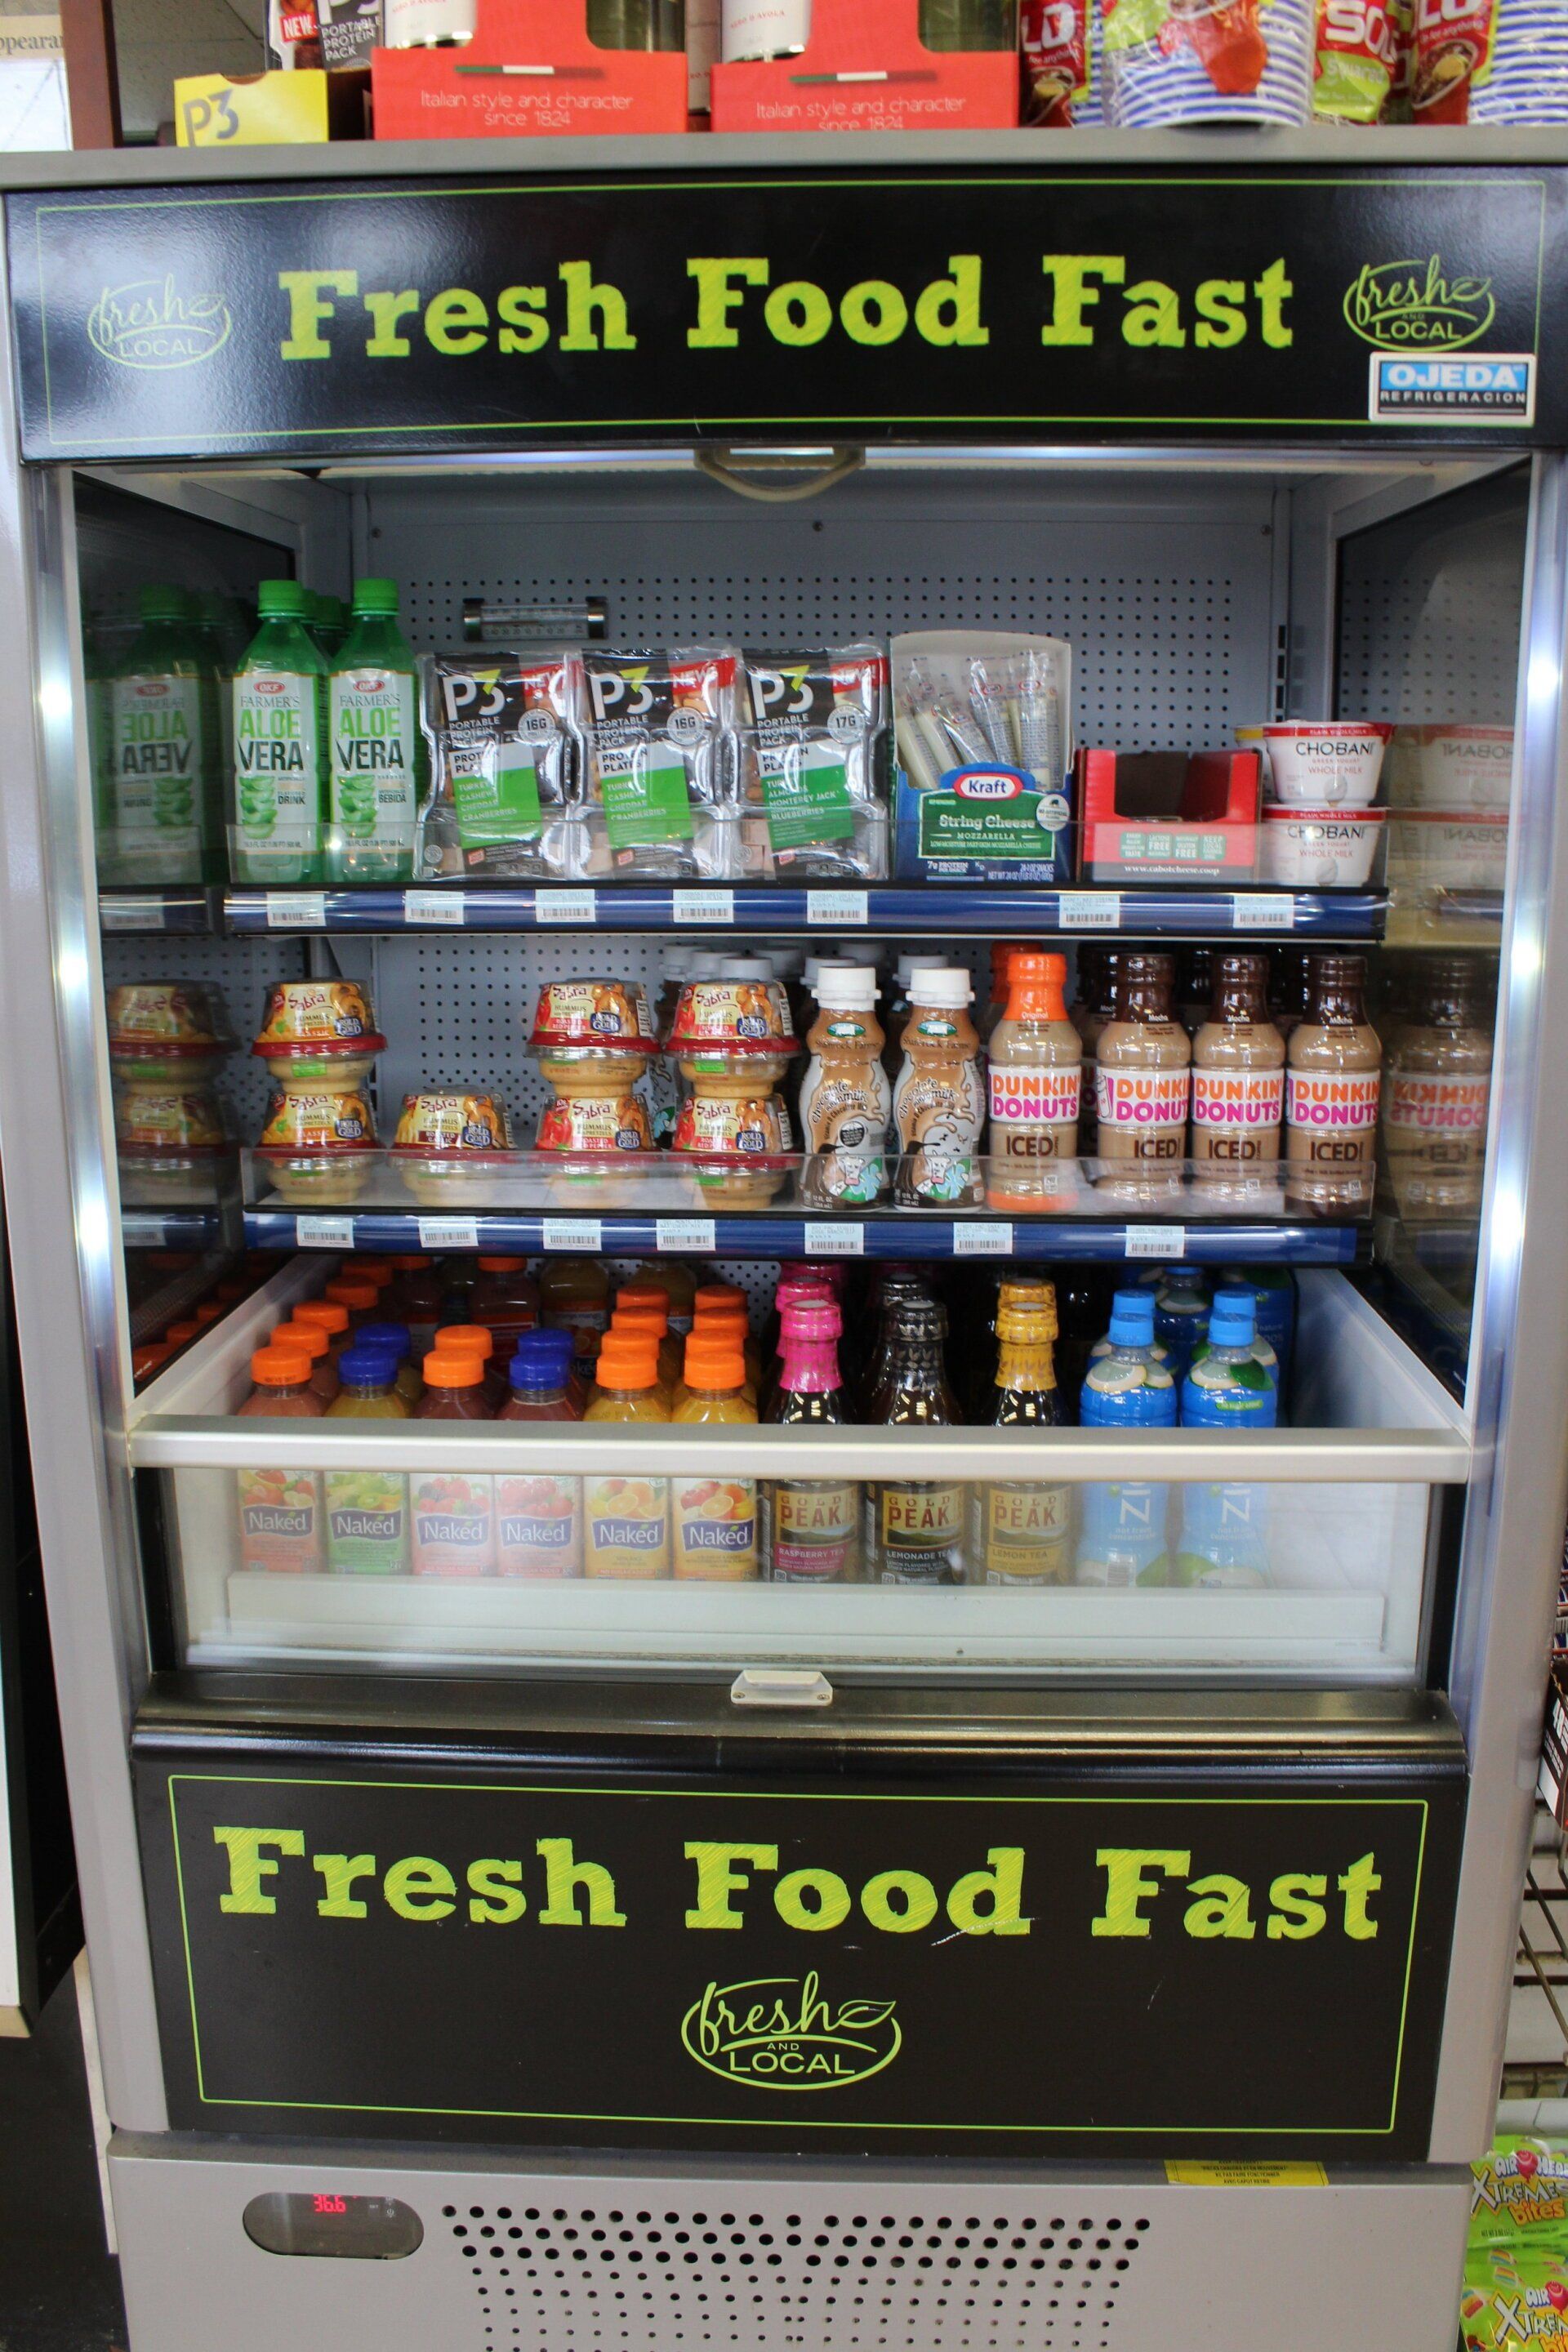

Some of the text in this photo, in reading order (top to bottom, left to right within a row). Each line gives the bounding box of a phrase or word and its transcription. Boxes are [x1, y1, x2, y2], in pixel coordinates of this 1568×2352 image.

[324, 30, 376, 49] PROTEIN
[327, 44, 357, 61] PACK
[421, 91, 633, 111] Italian style and character
[756, 96, 966, 120] Italian style and character
[181, 88, 239, 148] P3
[484, 110, 571, 127] since 1824
[818, 115, 903, 131] since 1824
[1356, 253, 1453, 327] fresh
[99, 272, 187, 347] fresh
[278, 254, 1294, 361] Fresh Food Fast
[1375, 321, 1462, 340] LOCAL
[119, 338, 202, 358] LOCAL
[1388, 363, 1517, 389] OJEDA
[1379, 390, 1526, 403] REFRIGERACION
[339, 693, 402, 707] FARMER'S
[442, 668, 506, 722] P3
[589, 666, 654, 721] P3
[750, 664, 814, 719] P3
[240, 695, 301, 708] FARMER'S
[239, 709, 301, 739] ALOE
[338, 706, 402, 738] ALOE
[449, 716, 501, 731] PORTABLE
[527, 718, 547, 731] 16G
[596, 714, 649, 730] PORTABLE
[675, 716, 695, 728] 16G
[757, 713, 809, 729] PORTABLE
[835, 715, 856, 728] 17G
[760, 736, 786, 747] PACK
[1295, 742, 1375, 756] CHOBANI
[237, 738, 305, 772] VERA
[335, 738, 404, 771] VERA
[1308, 766, 1363, 774] WHOLE MILK
[969, 780, 1007, 794] Kraft
[278, 795, 306, 805] DRINK
[768, 791, 836, 807] MONTEREY JACK
[462, 808, 518, 822] CRANBERRIES
[611, 808, 667, 821] CRANBERRIES
[771, 808, 825, 821] BLUEBERRIES
[939, 814, 1036, 831] String Cheese
[956, 832, 1015, 840] MOZZARELLA
[1149, 841, 1169, 850] FREE
[1175, 849, 1196, 858] FREE
[1299, 849, 1353, 858] WHOLE MILK
[1125, 866, 1220, 876] www.cabotcheese.coop
[288, 992, 325, 1011] Sabra
[553, 986, 587, 1000] Sabra
[696, 989, 731, 1008] Sabra
[1227, 1015, 1250, 1023] Mocha
[1328, 1017, 1352, 1025] Mocha
[992, 1074, 1081, 1097] DUNKIN'
[288, 1094, 328, 1110] Sabra
[420, 1095, 457, 1111] Sabra
[572, 1100, 611, 1120] Sabra
[697, 1099, 731, 1120] Sabra
[992, 1096, 1078, 1120] DONUTS
[1116, 1101, 1188, 1122] DONUT
[1196, 1099, 1280, 1123] DONUTS
[1294, 1102, 1379, 1125] DONUTS
[466, 1134, 491, 1144] GOLD
[1006, 1135, 1053, 1157] ICED
[1134, 1139, 1178, 1159] ICED
[1208, 1140, 1257, 1160] ICED
[1311, 1141, 1359, 1161] ICED
[781, 1495, 842, 1507] GOLD
[889, 1496, 951, 1507] GOLD
[995, 1495, 1057, 1507] GOLD
[248, 1512, 307, 1531] Naked
[336, 1514, 395, 1535] Naked
[780, 1504, 842, 1527] PEAK
[889, 1506, 950, 1528] PEAK
[994, 1505, 1057, 1528] PEAK
[424, 1520, 483, 1540] Naked
[506, 1522, 566, 1543] Naked
[599, 1525, 659, 1544] Naked
[689, 1526, 748, 1545] Naked
[778, 1548, 828, 1558] RASPBERRY
[887, 1550, 936, 1560] LEMONADE
[992, 1548, 1048, 1559] LEMON TEA
[212, 1825, 1382, 1940] Fresh Food Fast
[699, 1970, 841, 2056] fresh
[766, 2042, 800, 2051] AND
[728, 2052, 855, 2074] LOCAL
[1494, 2154, 1568, 2178] AIR HEA
[1509, 2199, 1566, 2226] bites
[1525, 2287, 1550, 2307] AIR
